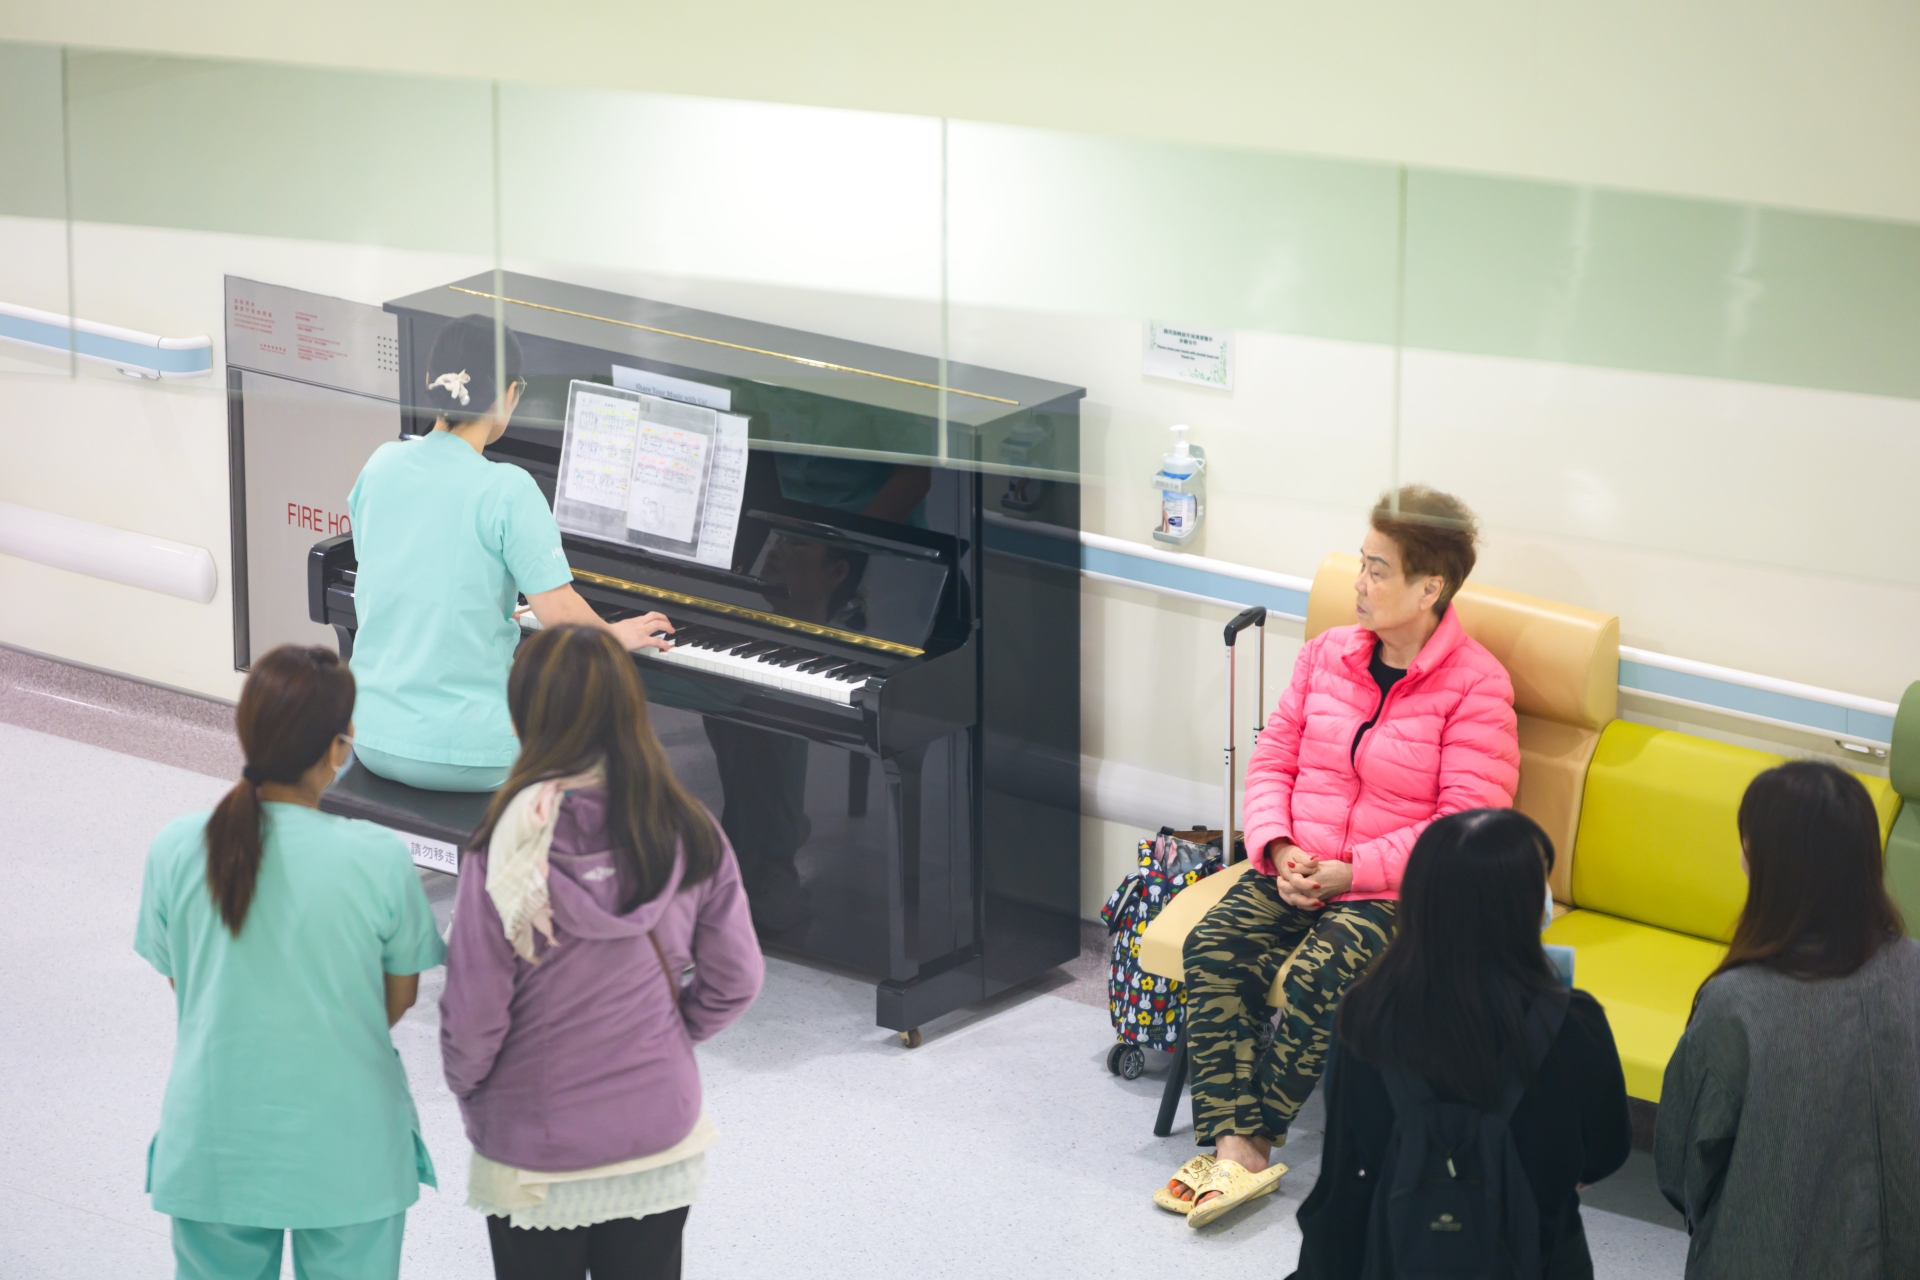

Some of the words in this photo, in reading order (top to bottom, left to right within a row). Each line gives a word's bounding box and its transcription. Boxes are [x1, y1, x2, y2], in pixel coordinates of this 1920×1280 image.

[635, 383, 651, 393] Share
[652, 387, 666, 396] Your
[666, 391, 682, 400] Music
[685, 395, 697, 403] with
[698, 398, 707, 406] Us!
[287, 502, 324, 533] FIRE
[328, 511, 352, 537] HO
[411, 841, 456, 865] 請勿移走
